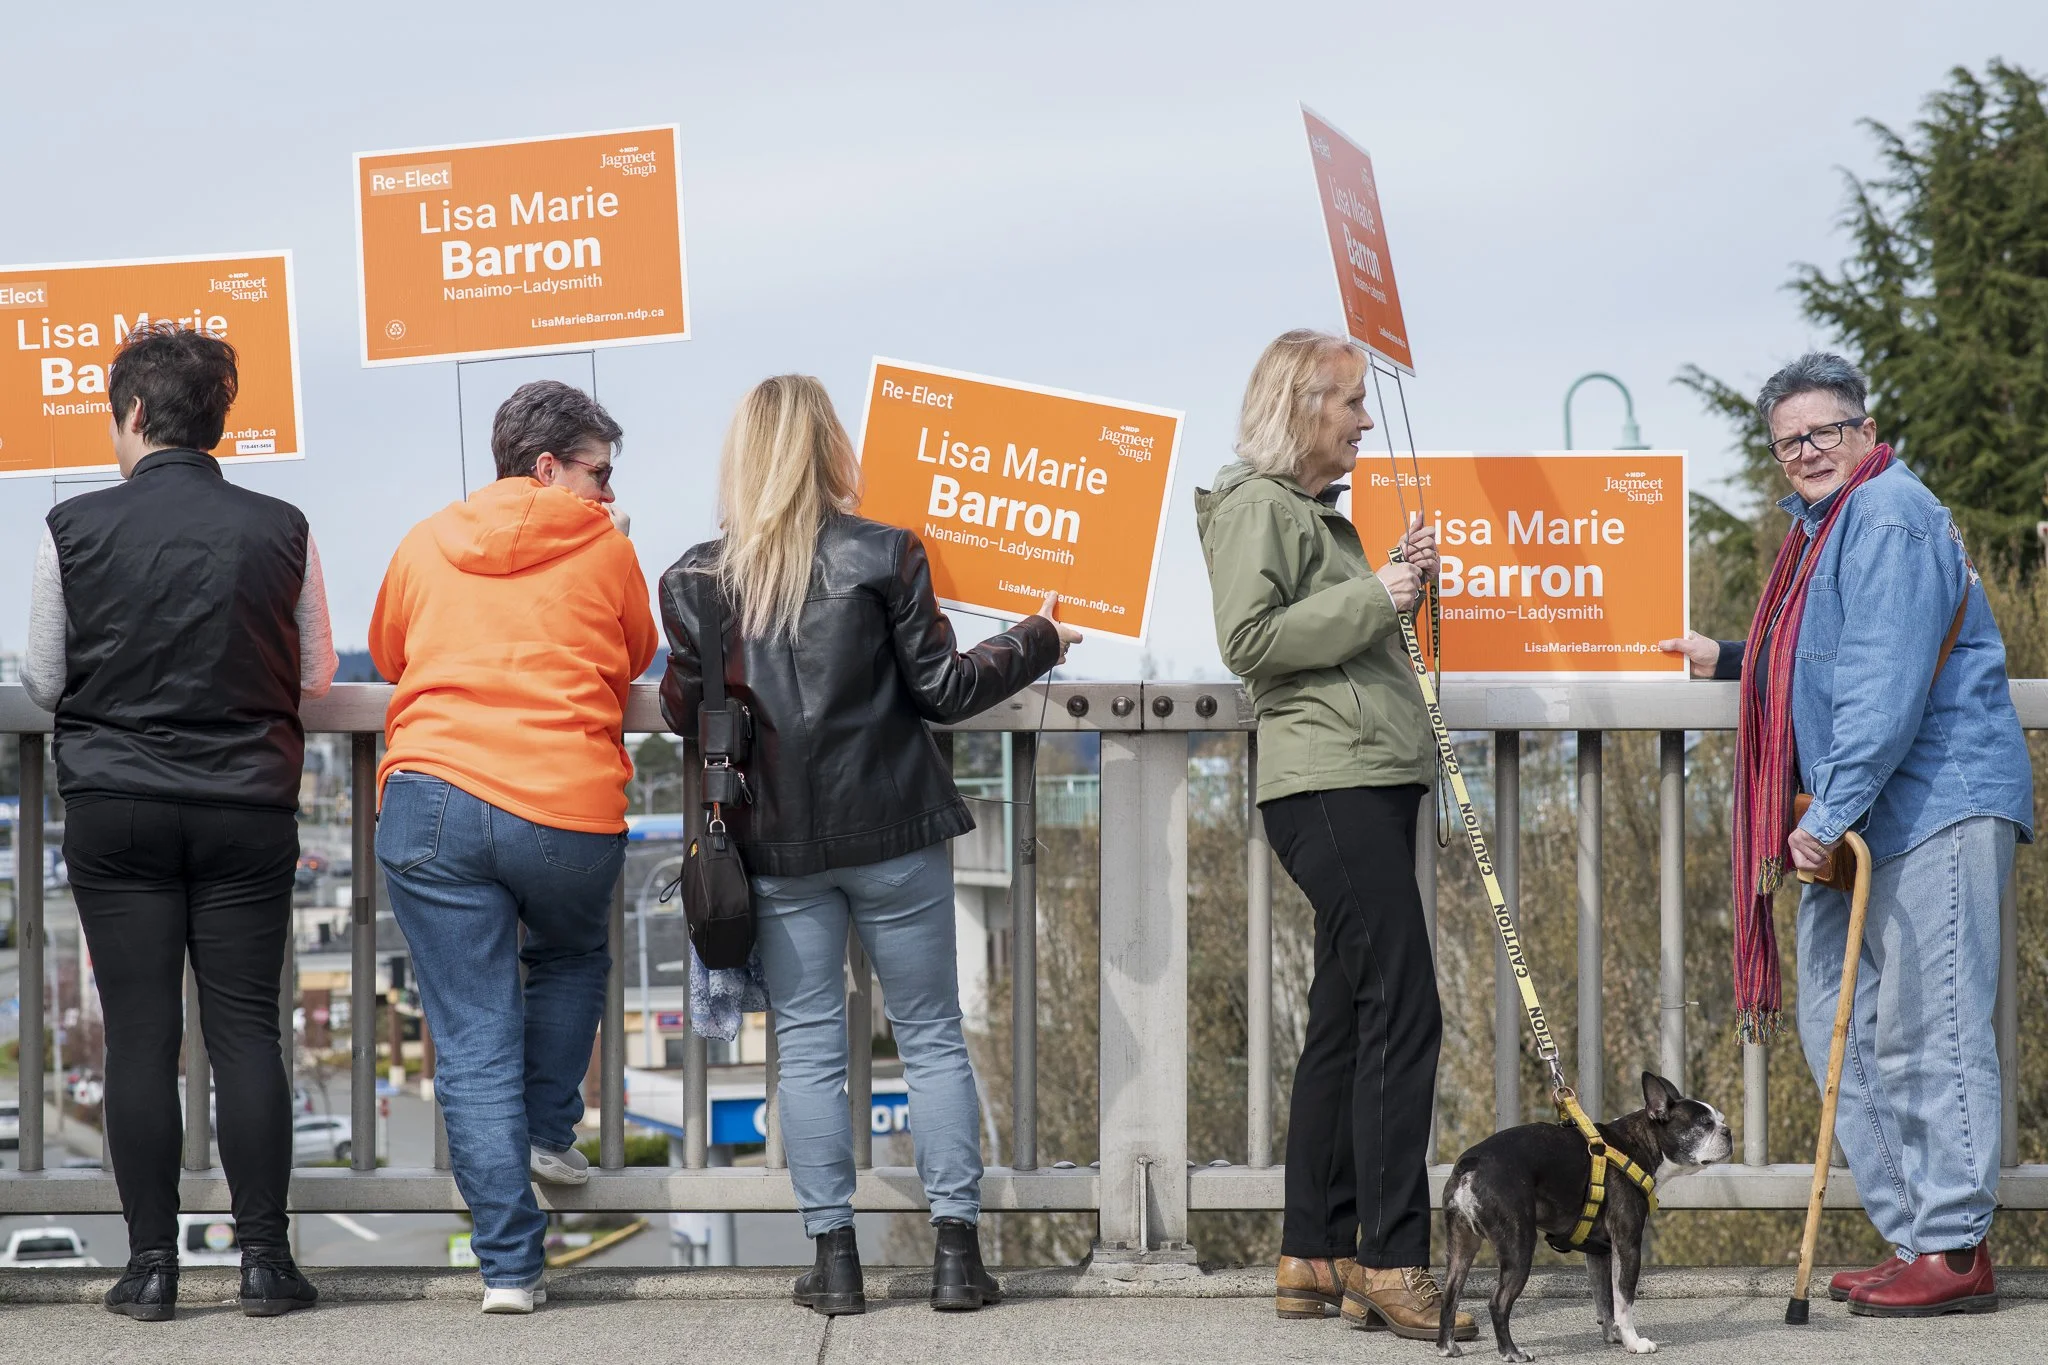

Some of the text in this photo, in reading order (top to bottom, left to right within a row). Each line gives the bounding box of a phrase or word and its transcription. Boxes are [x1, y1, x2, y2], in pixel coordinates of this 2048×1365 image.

[600, 151, 656, 168] Jagmeet
[622, 162, 657, 177] Singh
[372, 168, 449, 191] Re-Elect
[419, 186, 619, 234] Lisa Marie
[441, 236, 602, 281] Barron
[1342, 222, 1383, 283] Barron
[208, 276, 267, 293] Jagmeet
[231, 288, 268, 302] Singh
[17, 317, 100, 350] Lisa
[531, 308, 665, 329] LisaMarieBarron.ndp.ca
[881, 379, 954, 409] Re-Elect
[1098, 425, 1155, 449] Jagmeet
[916, 427, 1108, 495] Lisa Marie
[1118, 444, 1152, 463] Singh
[1370, 473, 1432, 487] Re-Elect
[1604, 476, 1664, 493] Jagmeet
[927, 474, 1081, 544] Barron
[1627, 489, 1664, 505] Singh
[1507, 509, 1625, 546] Marie
[1439, 555, 1604, 598] Barron
[998, 580, 1126, 615] LisaMariearron.ndp.ca
[1440, 605, 1604, 623] anaimo–Ladysmith
[1400, 613, 1427, 675] CAUTIO
[1427, 702, 1460, 775] CAUTION
[1460, 802, 1494, 876] CAUTION
[1493, 903, 1529, 978] CAUTION
